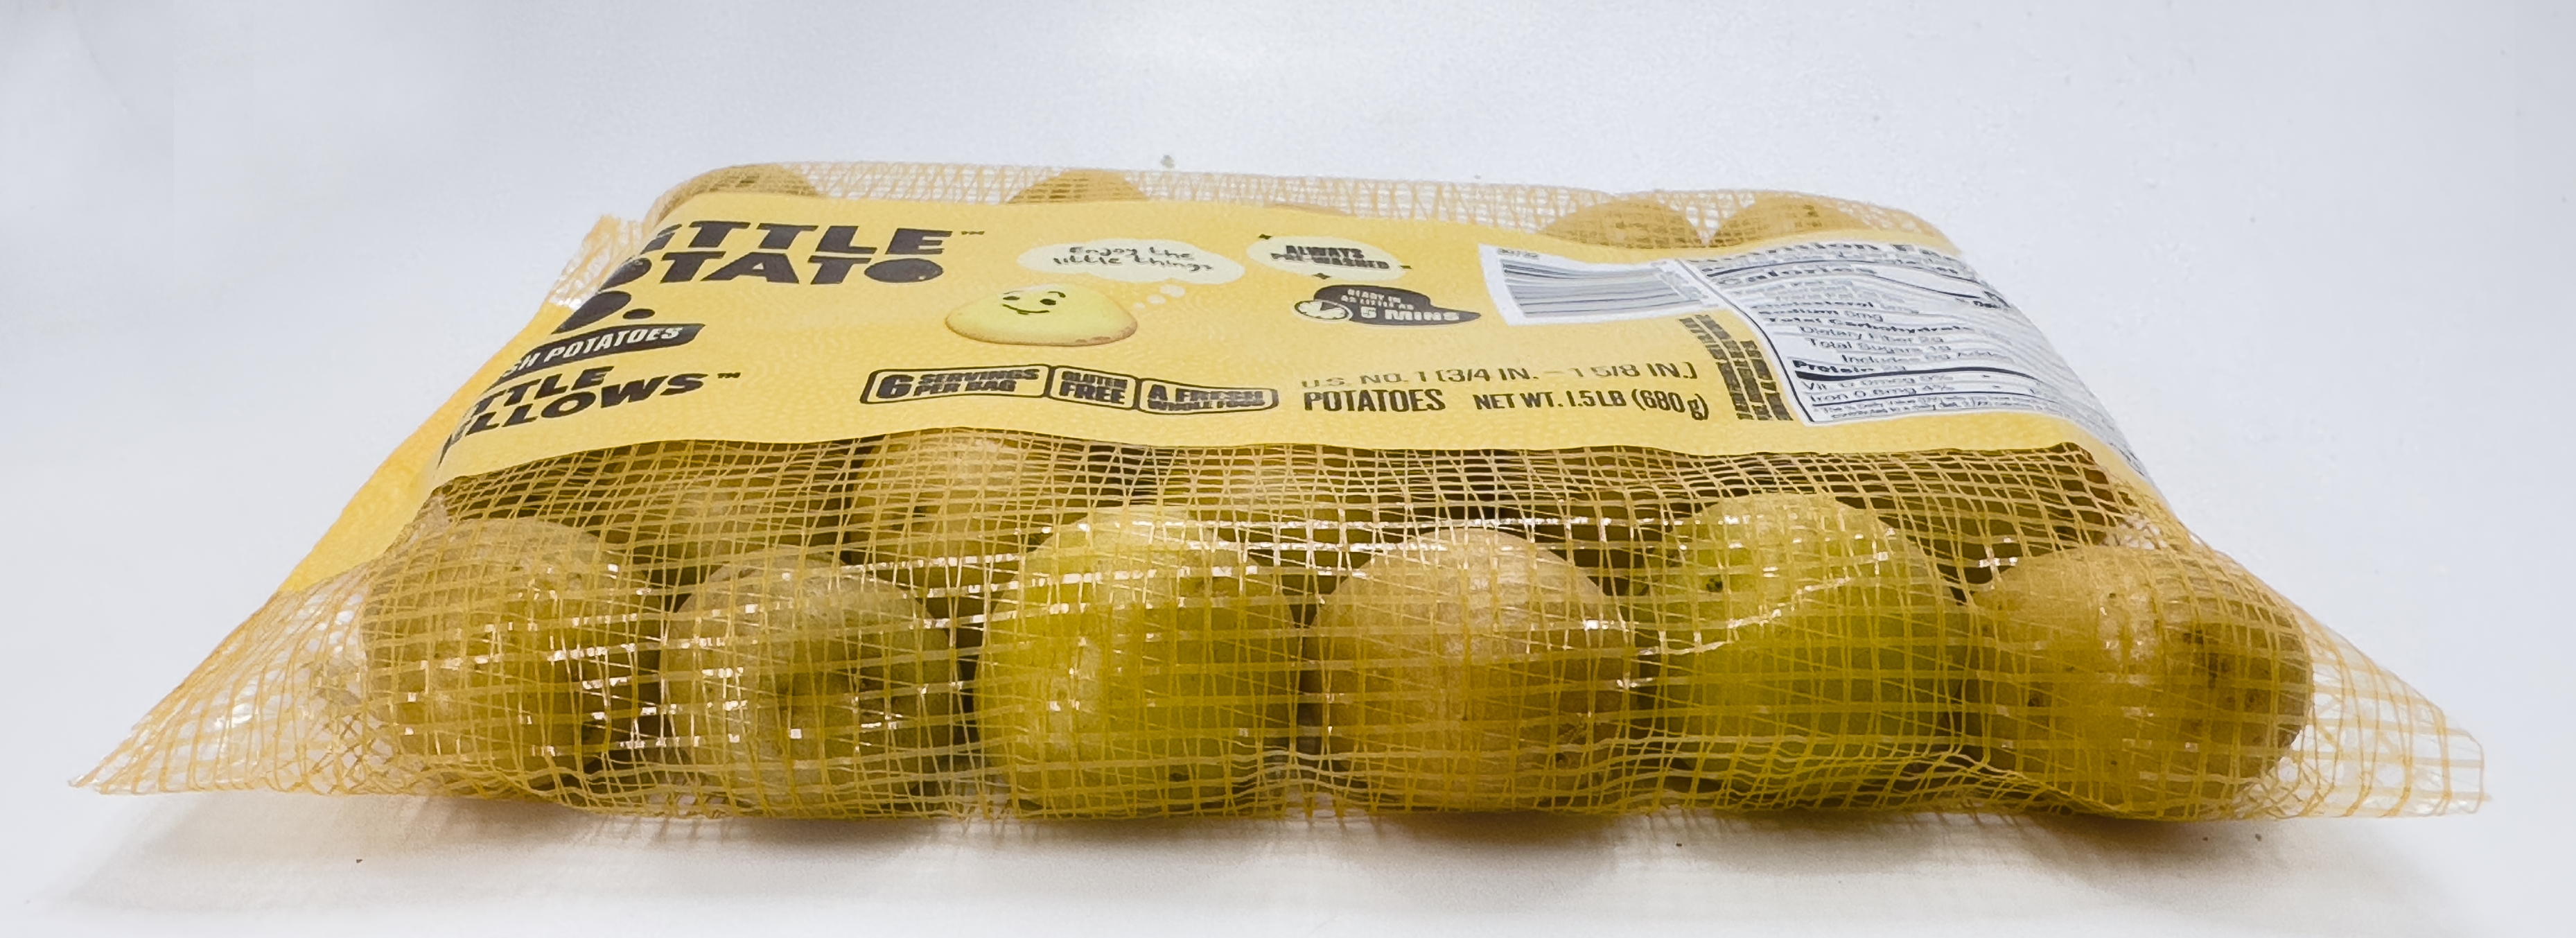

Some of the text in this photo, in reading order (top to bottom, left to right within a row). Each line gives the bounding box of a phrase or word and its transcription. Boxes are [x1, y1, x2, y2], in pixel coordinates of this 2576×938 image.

[640, 220, 953, 255] ITTLE
[1069, 246, 1195, 260] Enjoy the
[1285, 245, 1365, 260] ALWAYS
[597, 251, 944, 292] OTATO
[1053, 254, 1213, 272] little things
[1360, 306, 1460, 321] 5 MINS
[544, 326, 685, 363] POTATOES
[1807, 338, 1852, 349] Total
[1360, 373, 1410, 385] NO.
[1417, 370, 1428, 383] 1
[1498, 367, 1540, 381] IN.
[1568, 367, 1585, 378] 1
[1590, 363, 1642, 378] 5/8
[1792, 359, 1875, 373] Protein
[876, 374, 915, 399] 6
[965, 379, 1017, 392] BAG
[1059, 381, 1126, 405] FREE
[1148, 384, 1168, 401] A
[1304, 388, 1446, 412] POTATOES
[1473, 393, 1516, 410] NET
[1520, 391, 1564, 408] WT.
[1809, 392, 1849, 403] Iron
